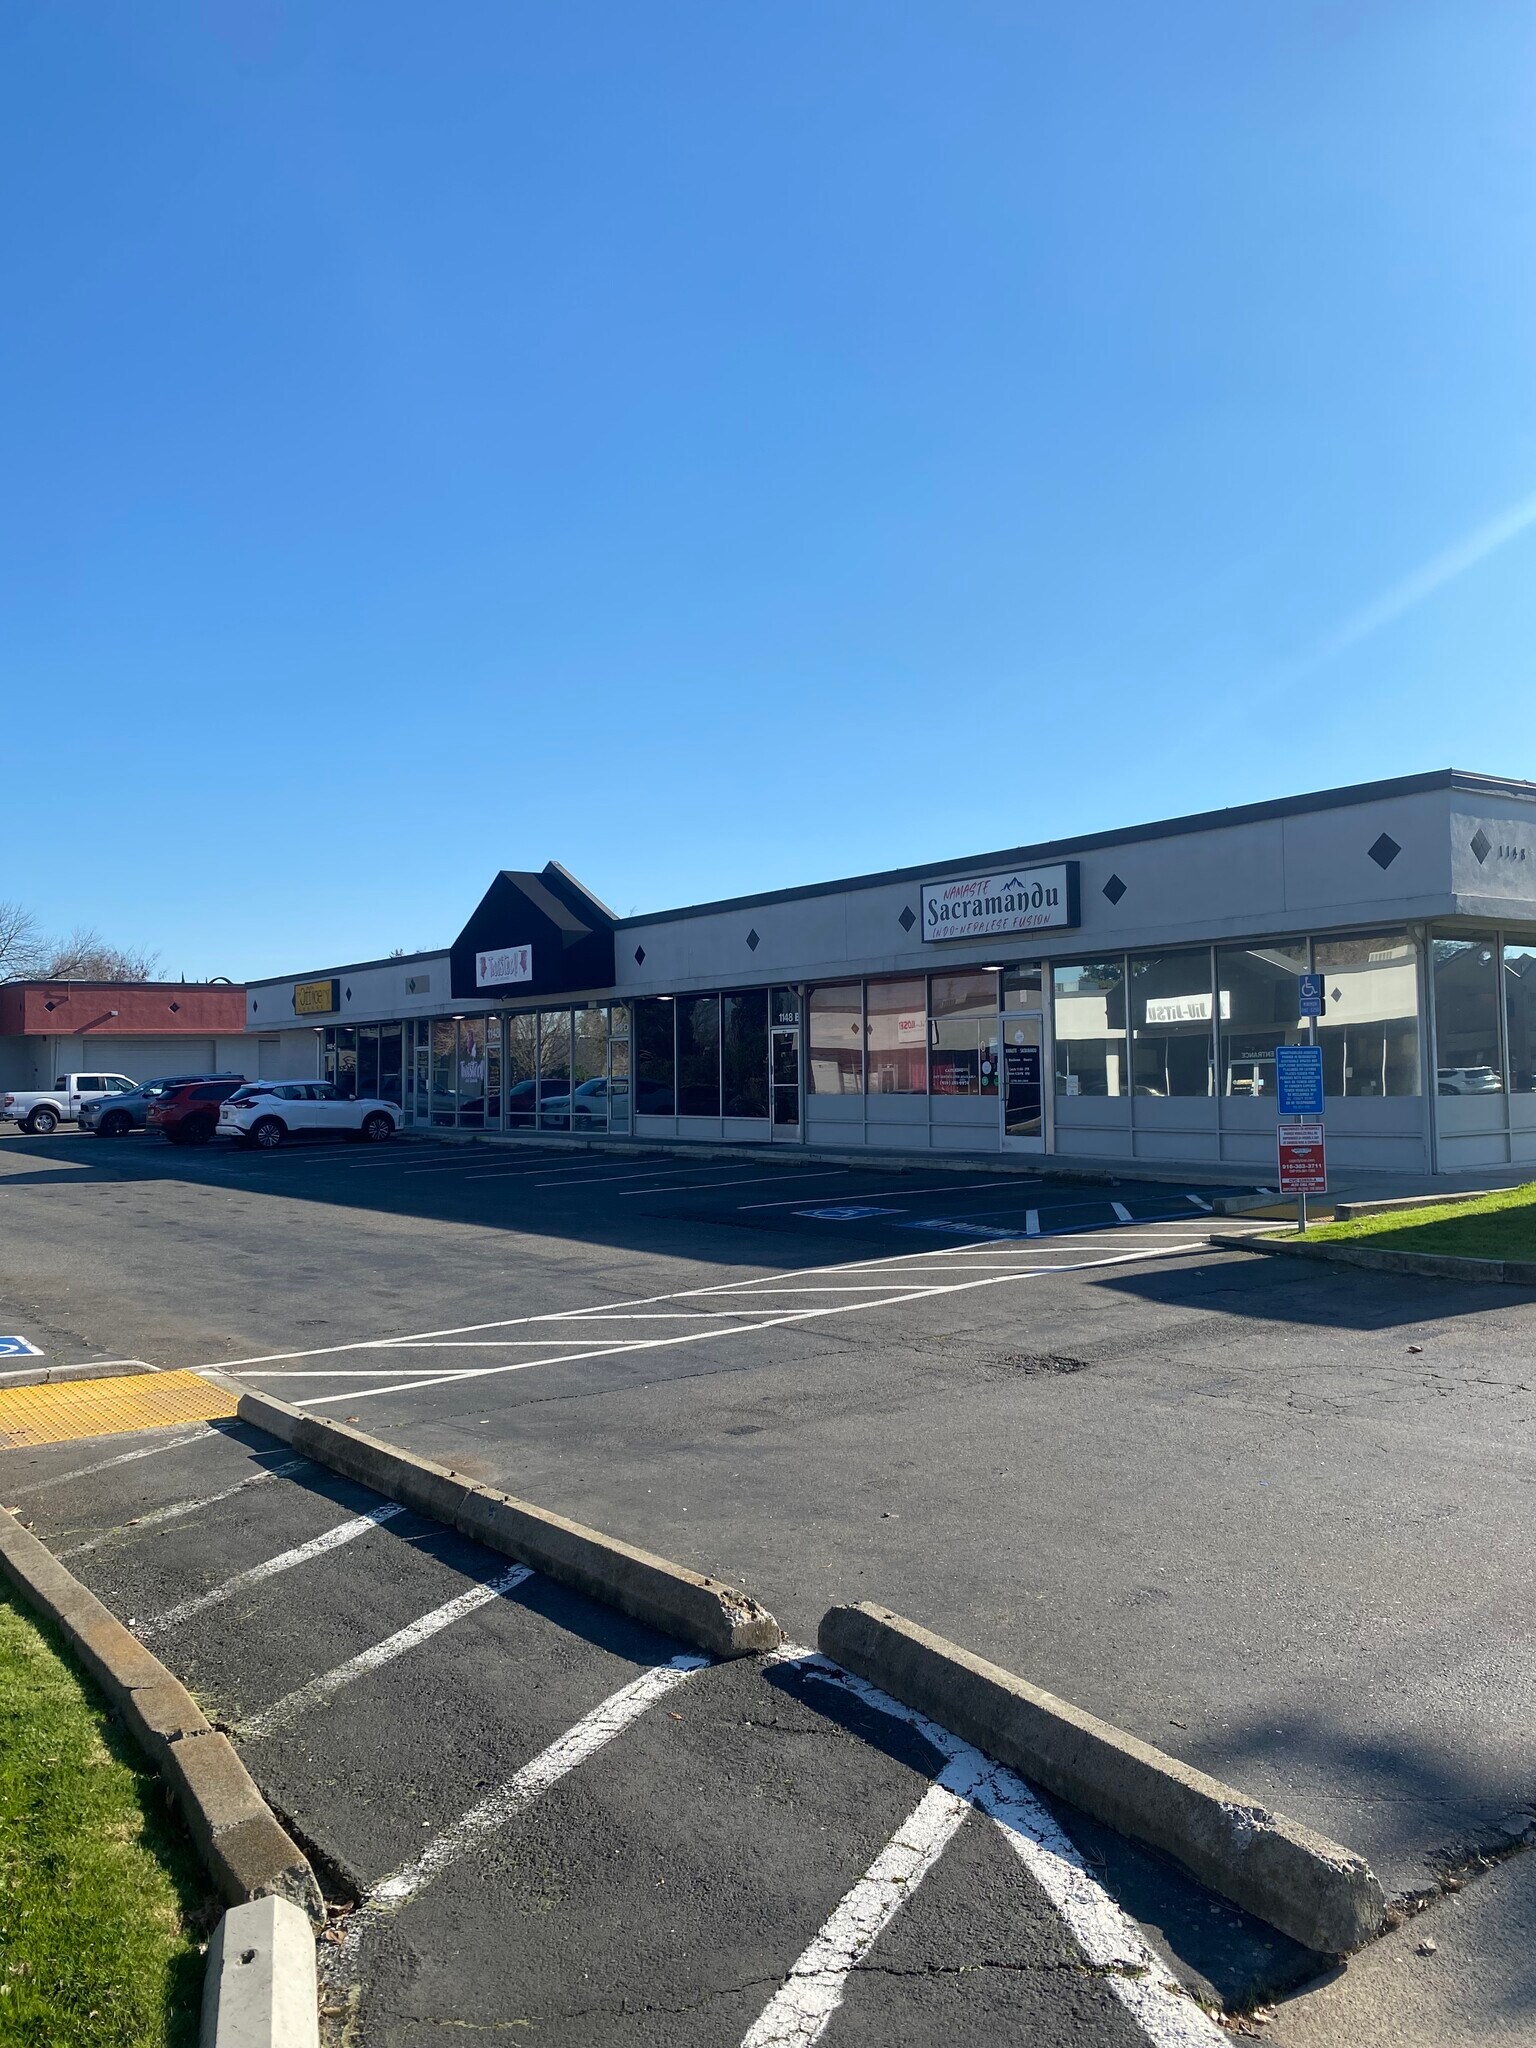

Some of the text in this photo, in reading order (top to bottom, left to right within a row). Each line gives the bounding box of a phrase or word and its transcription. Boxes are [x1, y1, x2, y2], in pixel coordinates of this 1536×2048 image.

[1499, 845, 1526, 861] 1148
[943, 880, 991, 900] NAMASTE
[928, 882, 1059, 926] Sacramandu
[932, 914, 1051, 938] INDO-NEPALESE FUSION
[779, 1012, 794, 1022] 1148
